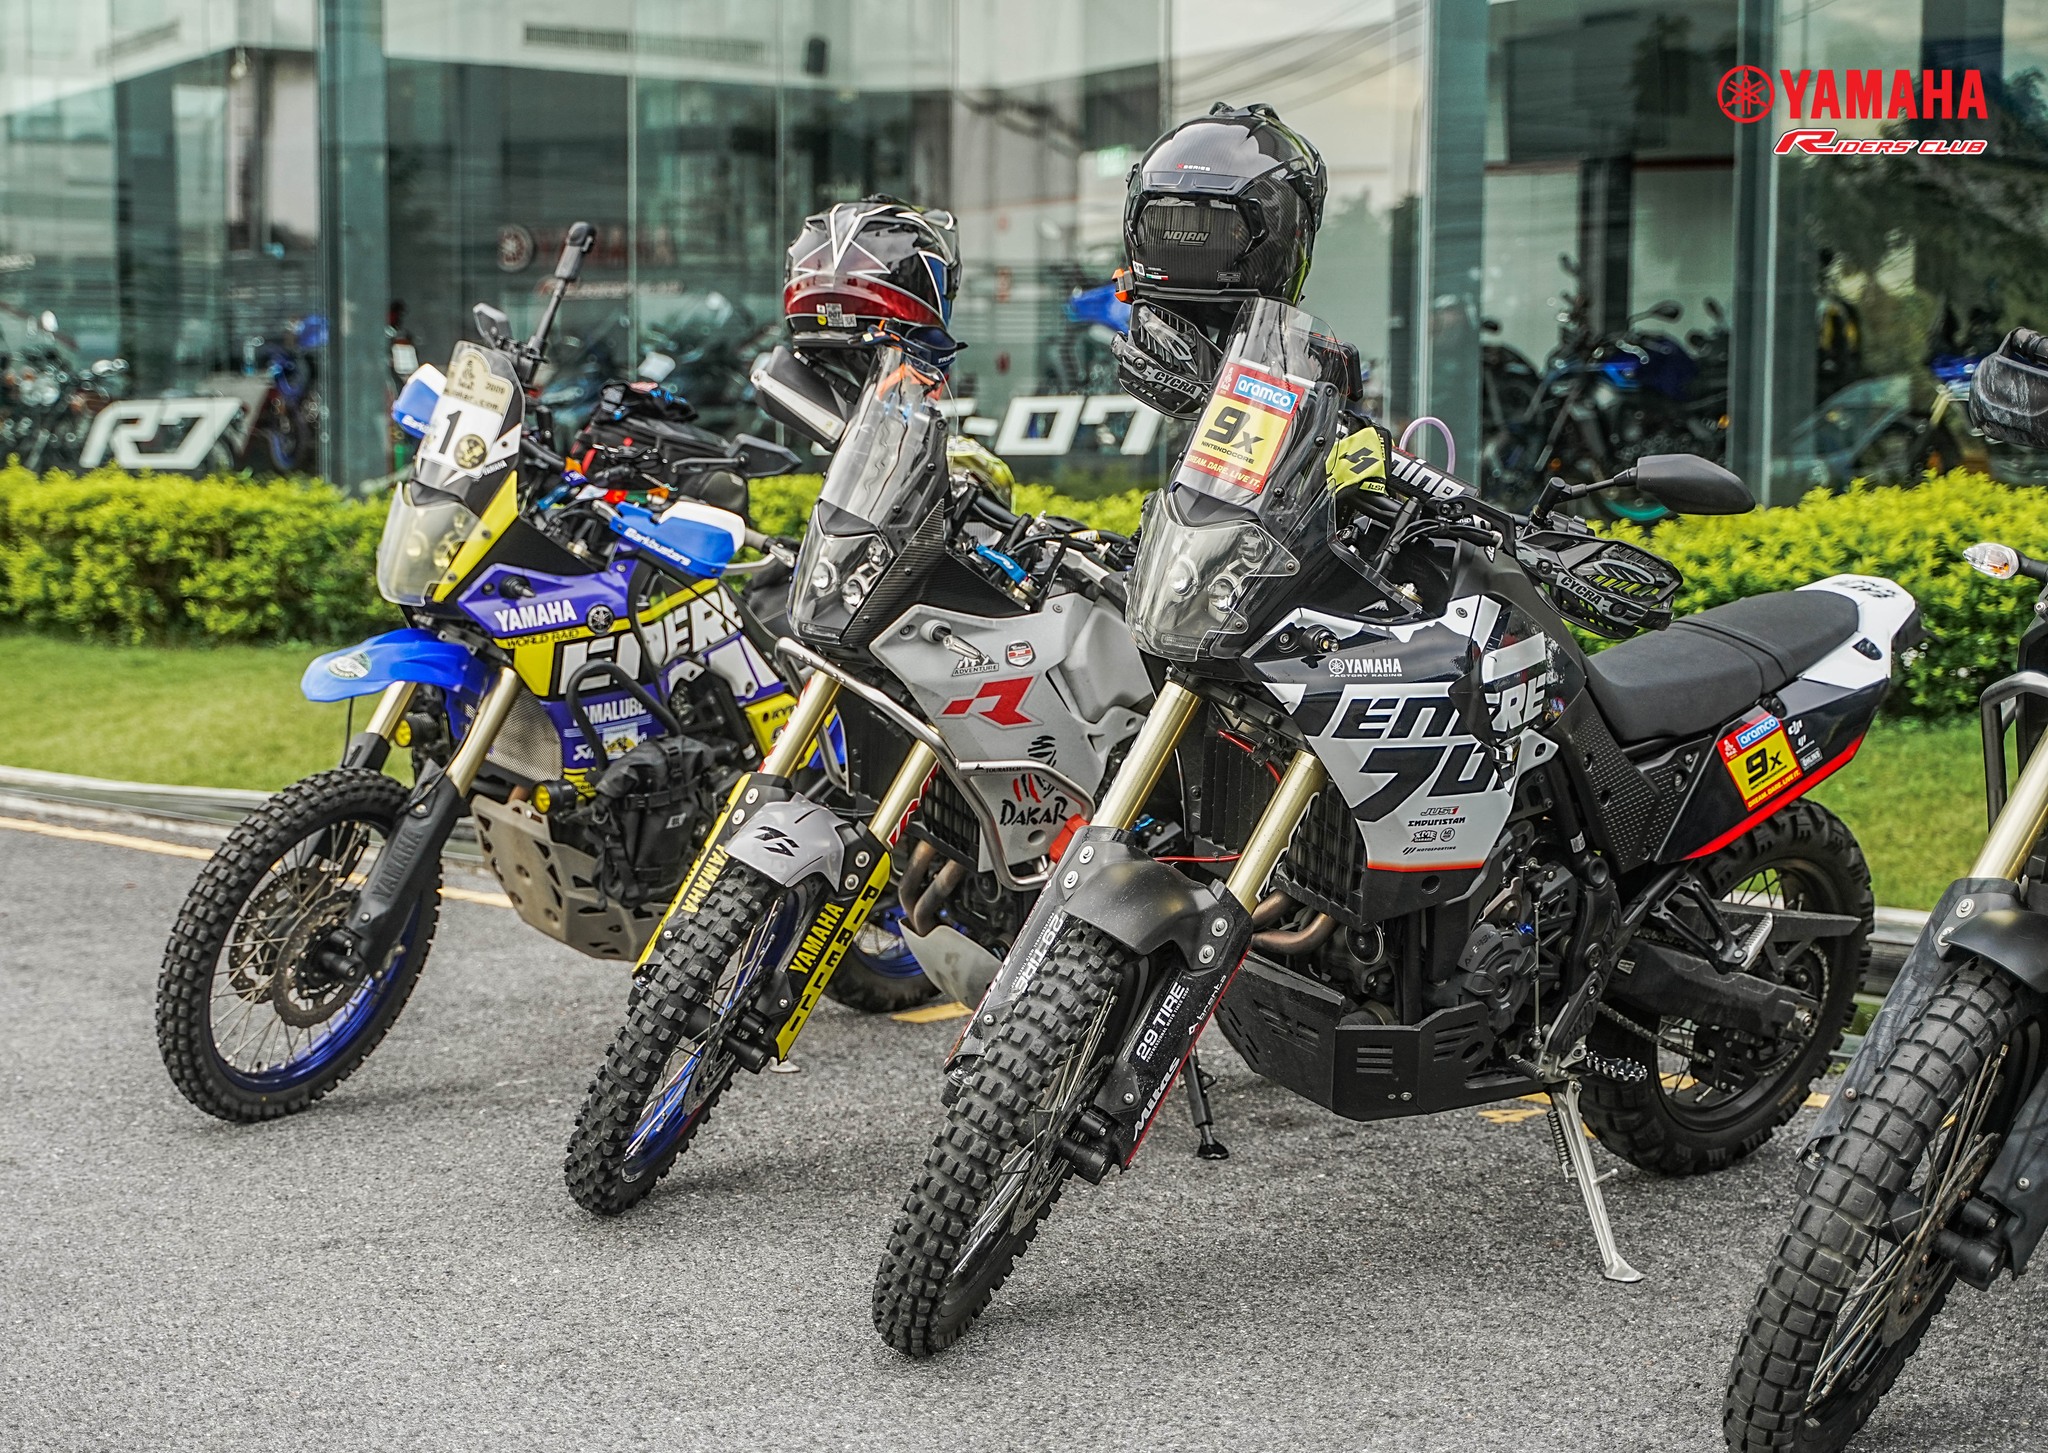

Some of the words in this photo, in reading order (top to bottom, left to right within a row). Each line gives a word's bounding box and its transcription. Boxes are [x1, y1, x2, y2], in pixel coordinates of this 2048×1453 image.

[1163, 230, 1209, 247] NOLAN
[1153, 371, 1197, 395] CYCRA
[1237, 380, 1291, 407] aramco
[79, 398, 241, 469] R7
[439, 410, 462, 455] 1
[1201, 440, 1255, 464] NINTENDOCORE
[1230, 469, 1251, 483] LIVE
[624, 527, 692, 567] Barkbusters
[1560, 576, 1605, 605] CYCRA
[494, 599, 578, 632] YAMAHA
[507, 632, 550, 648] WORLD
[953, 664, 998, 676] ADVENTURE
[1345, 658, 1402, 674] YAMAHA
[1740, 718, 1776, 745] aramco
[985, 766, 1022, 774] TOURATECH
[999, 796, 1069, 826] DAKAR
[1407, 816, 1467, 827] ENDURISTAN
[371, 830, 425, 899] YAMAHA
[681, 843, 730, 913] YAMAHA
[788, 901, 845, 975] YAMAHA
[1042, 914, 1064, 947] 29
[790, 884, 879, 1032] PIRELLI
[1196, 974, 1227, 1021] brenta
[1136, 1028, 1159, 1061] 29
[1152, 981, 1186, 1026] TIRE
[1133, 1056, 1180, 1142] Mitas
